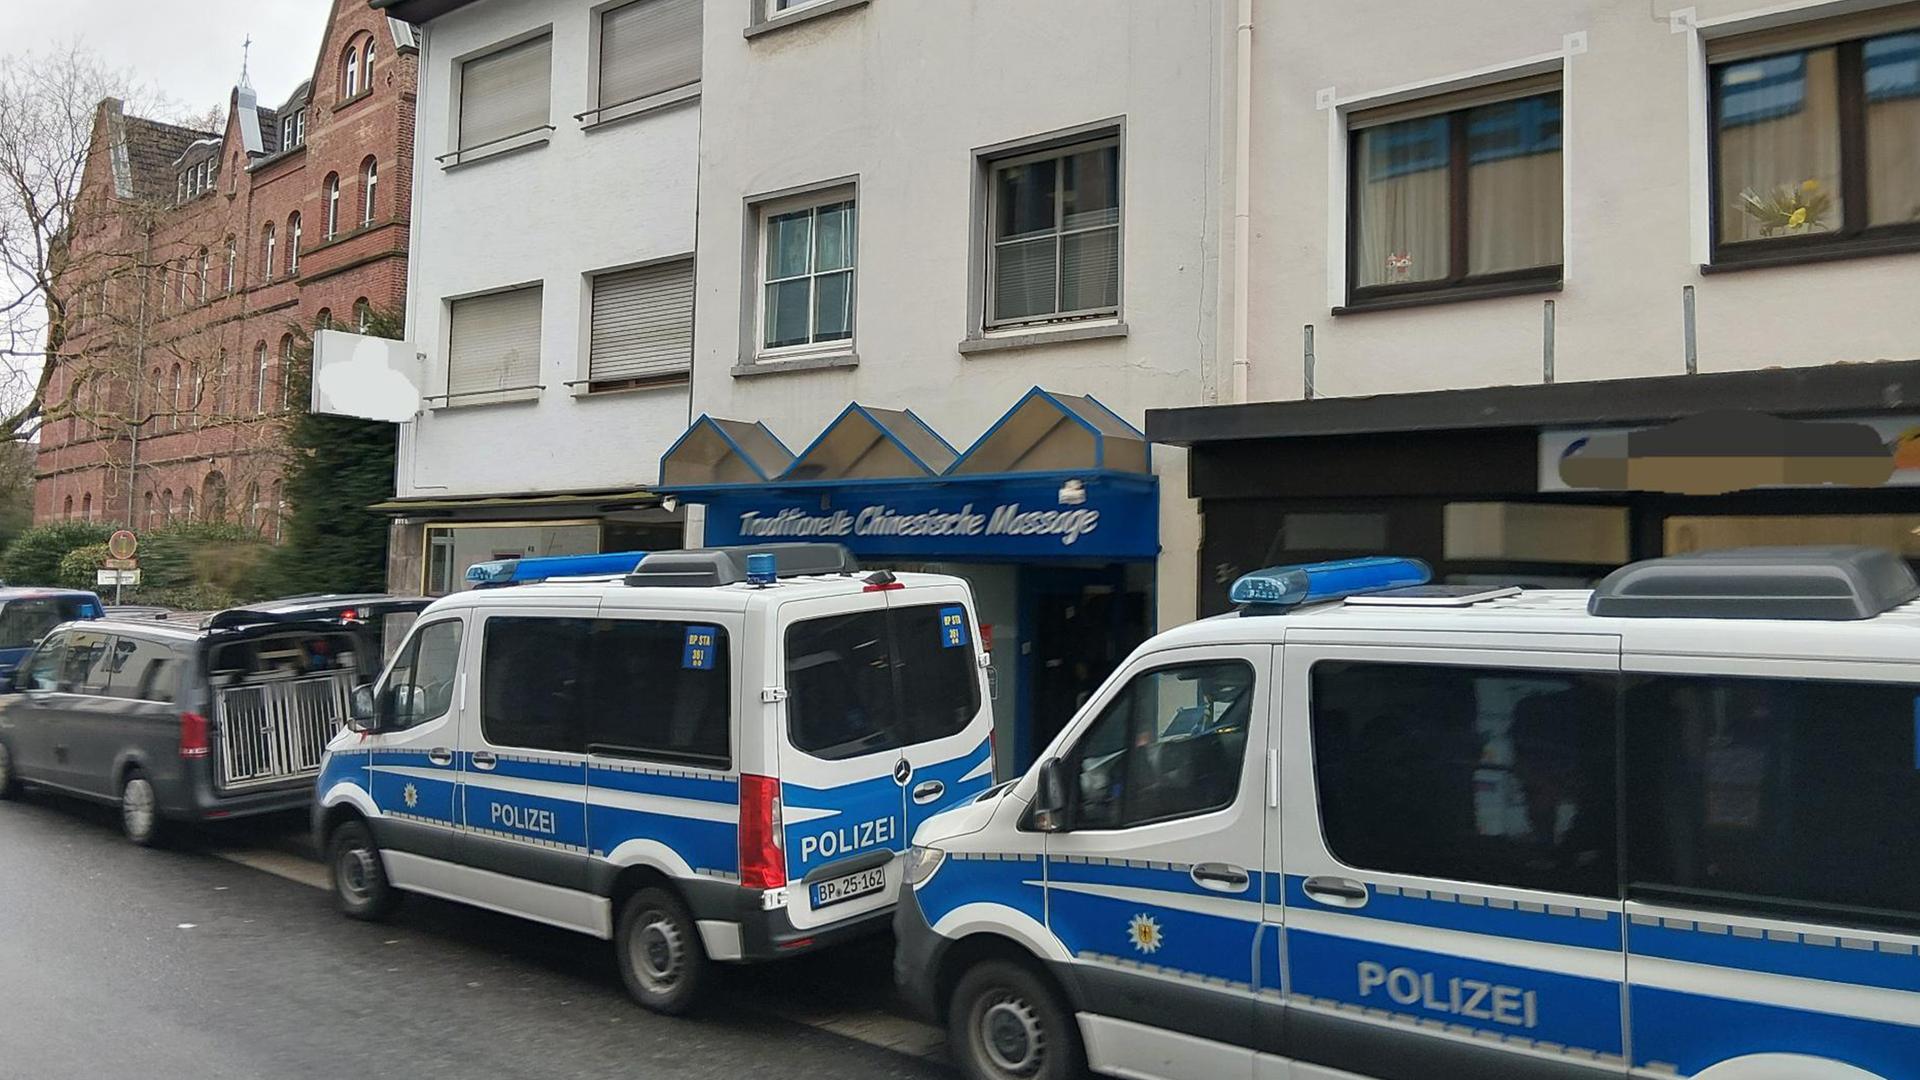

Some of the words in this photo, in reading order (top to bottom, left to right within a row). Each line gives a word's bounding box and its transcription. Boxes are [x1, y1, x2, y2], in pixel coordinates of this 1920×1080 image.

[739, 507, 855, 536] Traditionelle
[855, 504, 986, 536] Chinesische
[985, 503, 1100, 545] Massage
[491, 802, 555, 834] POLIZEI
[801, 816, 895, 862] POLIZEI
[819, 883, 835, 901] BP
[843, 869, 883, 895] 25-162
[1357, 960, 1537, 1028] POLIZEI
